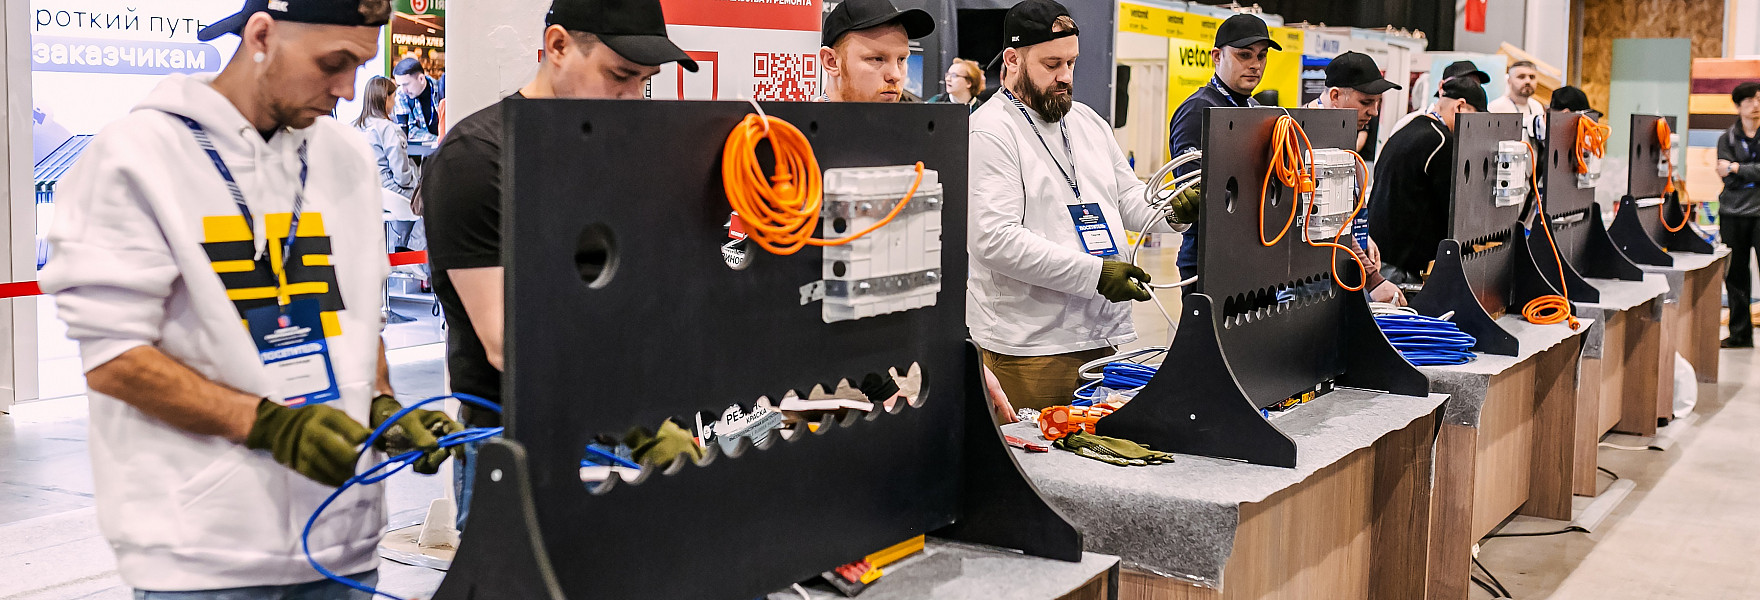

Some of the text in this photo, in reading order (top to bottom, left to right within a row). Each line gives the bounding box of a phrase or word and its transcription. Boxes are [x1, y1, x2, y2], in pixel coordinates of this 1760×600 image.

[36, 6, 140, 32] роткий
[392, 34, 444, 47] ГОРЯЧИЙ ХЛЕБ
[32, 42, 206, 70] заказчикам
